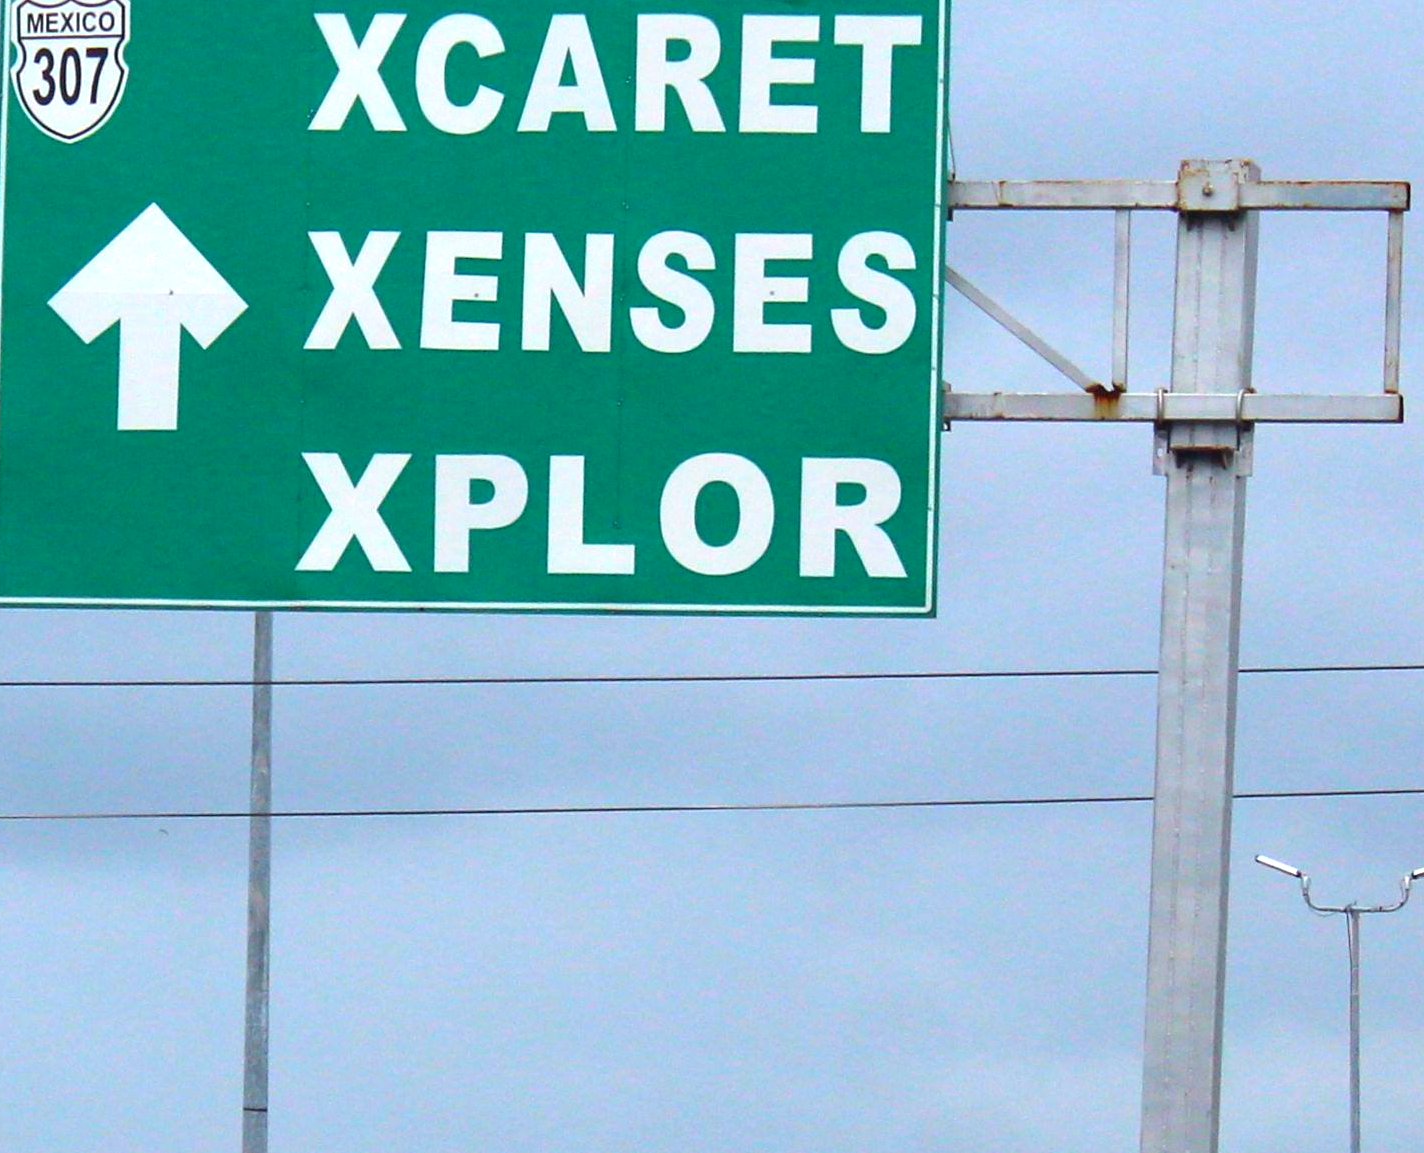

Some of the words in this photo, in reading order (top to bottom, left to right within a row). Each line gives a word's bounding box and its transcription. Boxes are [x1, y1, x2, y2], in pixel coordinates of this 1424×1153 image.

[26, 11, 116, 34] MEXICO
[32, 47, 110, 106] 307
[309, 12, 923, 135] XCARET
[303, 230, 917, 355] XENSES
[296, 451, 909, 579] XPLOR
